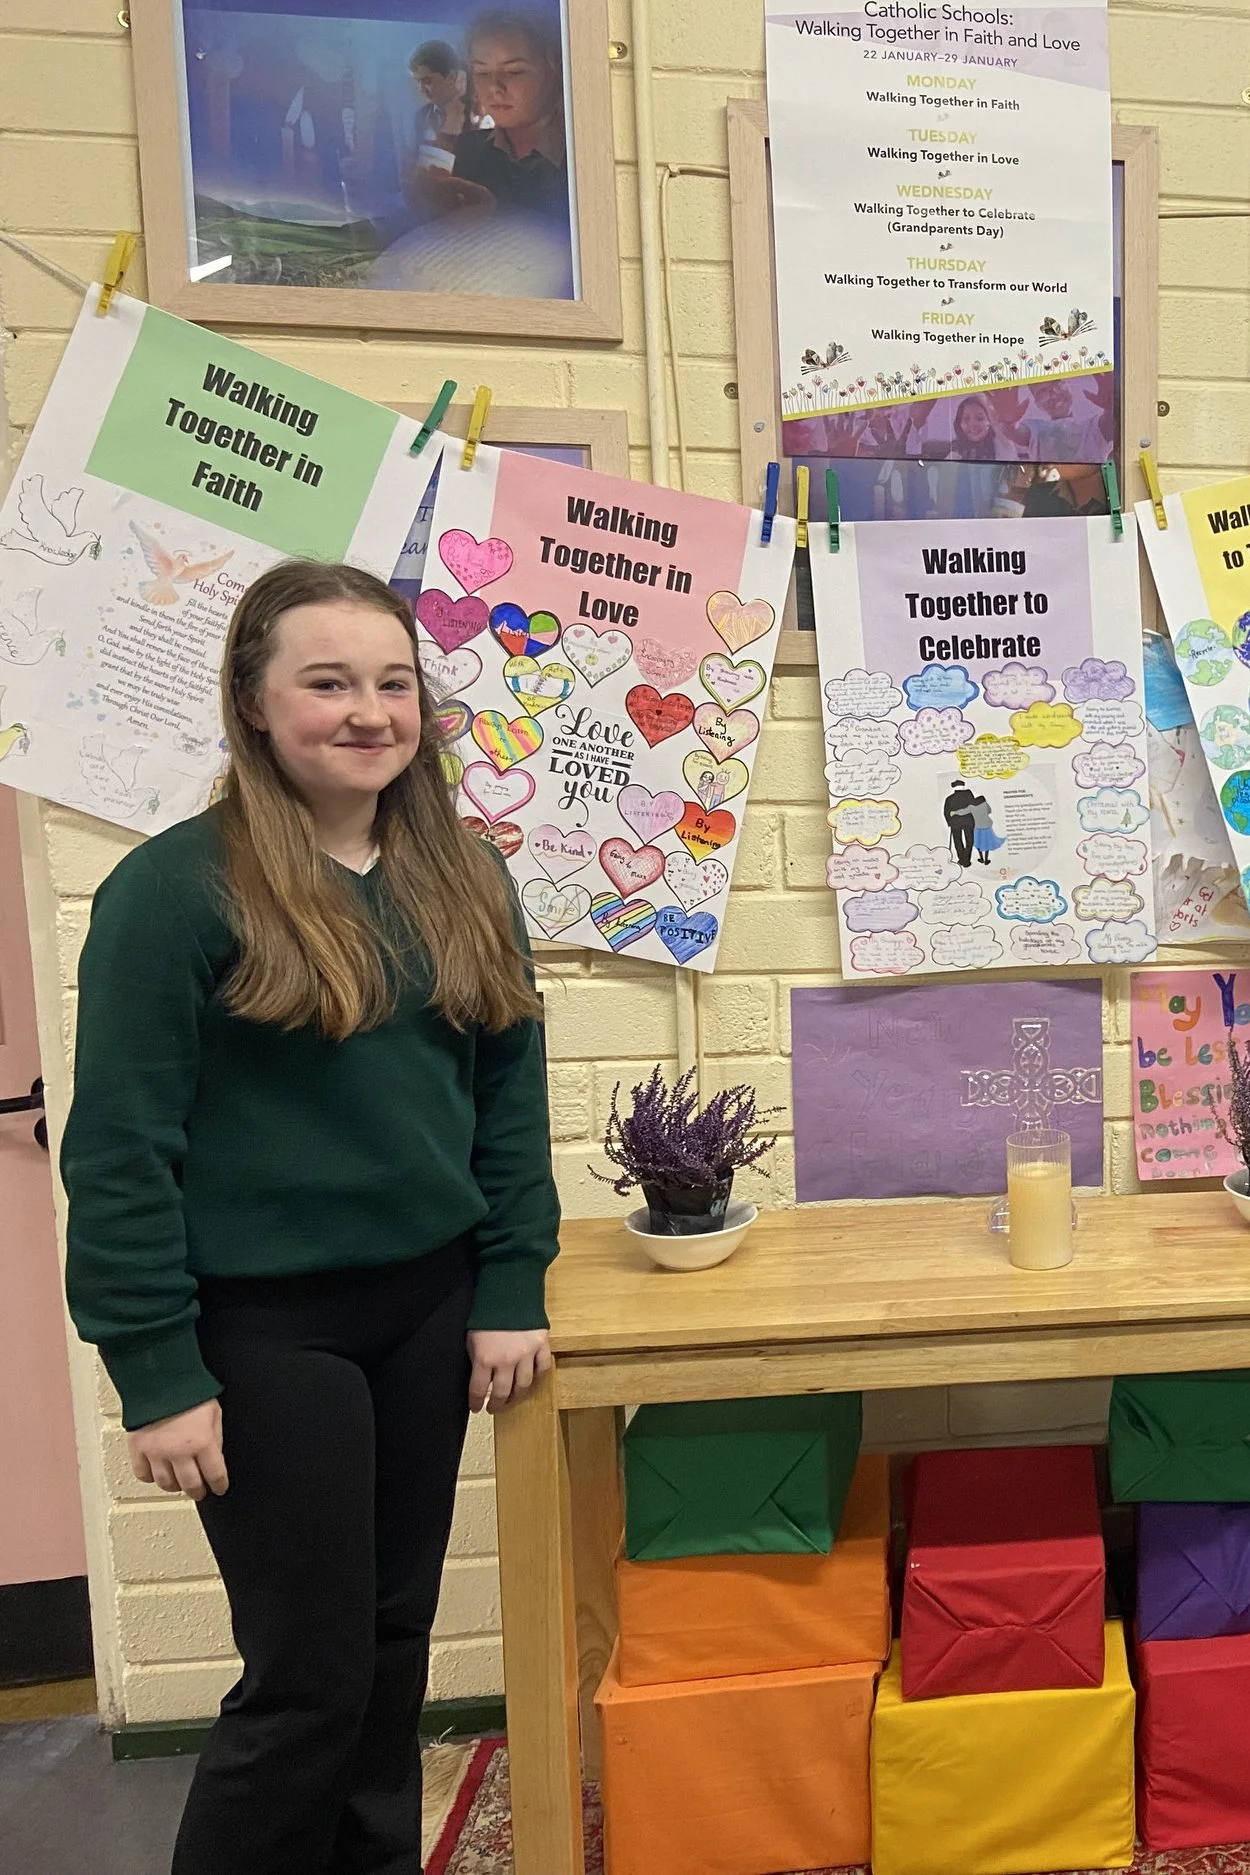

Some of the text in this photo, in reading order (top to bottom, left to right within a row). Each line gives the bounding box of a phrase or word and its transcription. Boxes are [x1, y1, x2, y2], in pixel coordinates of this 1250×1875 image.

[864, 0, 1014, 26] Catholic Schools:
[796, 20, 1080, 51] Walking Together in Faith and Love
[863, 50, 877, 59] 22
[962, 54, 1017, 68] JANUARY
[907, 74, 977, 90] MONDAY
[866, 91, 1020, 110] Walking Together in Faith
[908, 129, 977, 144] TUESDAY
[867, 147, 1019, 165] Walking Together in Love
[897, 185, 993, 200] WEDNESDAY
[854, 203, 1036, 221] Walking Together to Celebrate
[887, 222, 1004, 238] (Grandparents Day)
[907, 257, 986, 272] THURSDAY
[824, 274, 1067, 293] Walking Together to Transform our World
[922, 312, 975, 326] FRIDAY
[871, 330, 1025, 346] Walking Together in Hope
[202, 363, 319, 437] Walking
[165, 398, 323, 488] Together in
[191, 461, 263, 512] Faith
[567, 496, 678, 548] Walking
[540, 536, 692, 594] Together in
[922, 548, 1026, 575] Walking
[1223, 550, 1244, 570] to
[193, 579, 219, 600] Holy
[578, 591, 639, 627] Love
[905, 591, 1048, 620] Together to
[919, 634, 1041, 661] Celebrate
[422, 657, 459, 677] Think
[127, 716, 149, 730] Amen.
[555, 704, 634, 748] Love
[715, 717, 728, 734] By
[698, 726, 736, 747] Listening
[552, 737, 635, 761] ONE ANOTHER
[574, 751, 584, 759] AS
[591, 754, 610, 765] HAVE
[549, 757, 630, 786] LOVED
[695, 818, 710, 833] By
[542, 839, 586, 858] Be Kind
[680, 831, 721, 850] Listening
[663, 914, 675, 923] BE
[660, 926, 716, 944] POSITIVE
[1136, 1036, 1173, 1068] be
